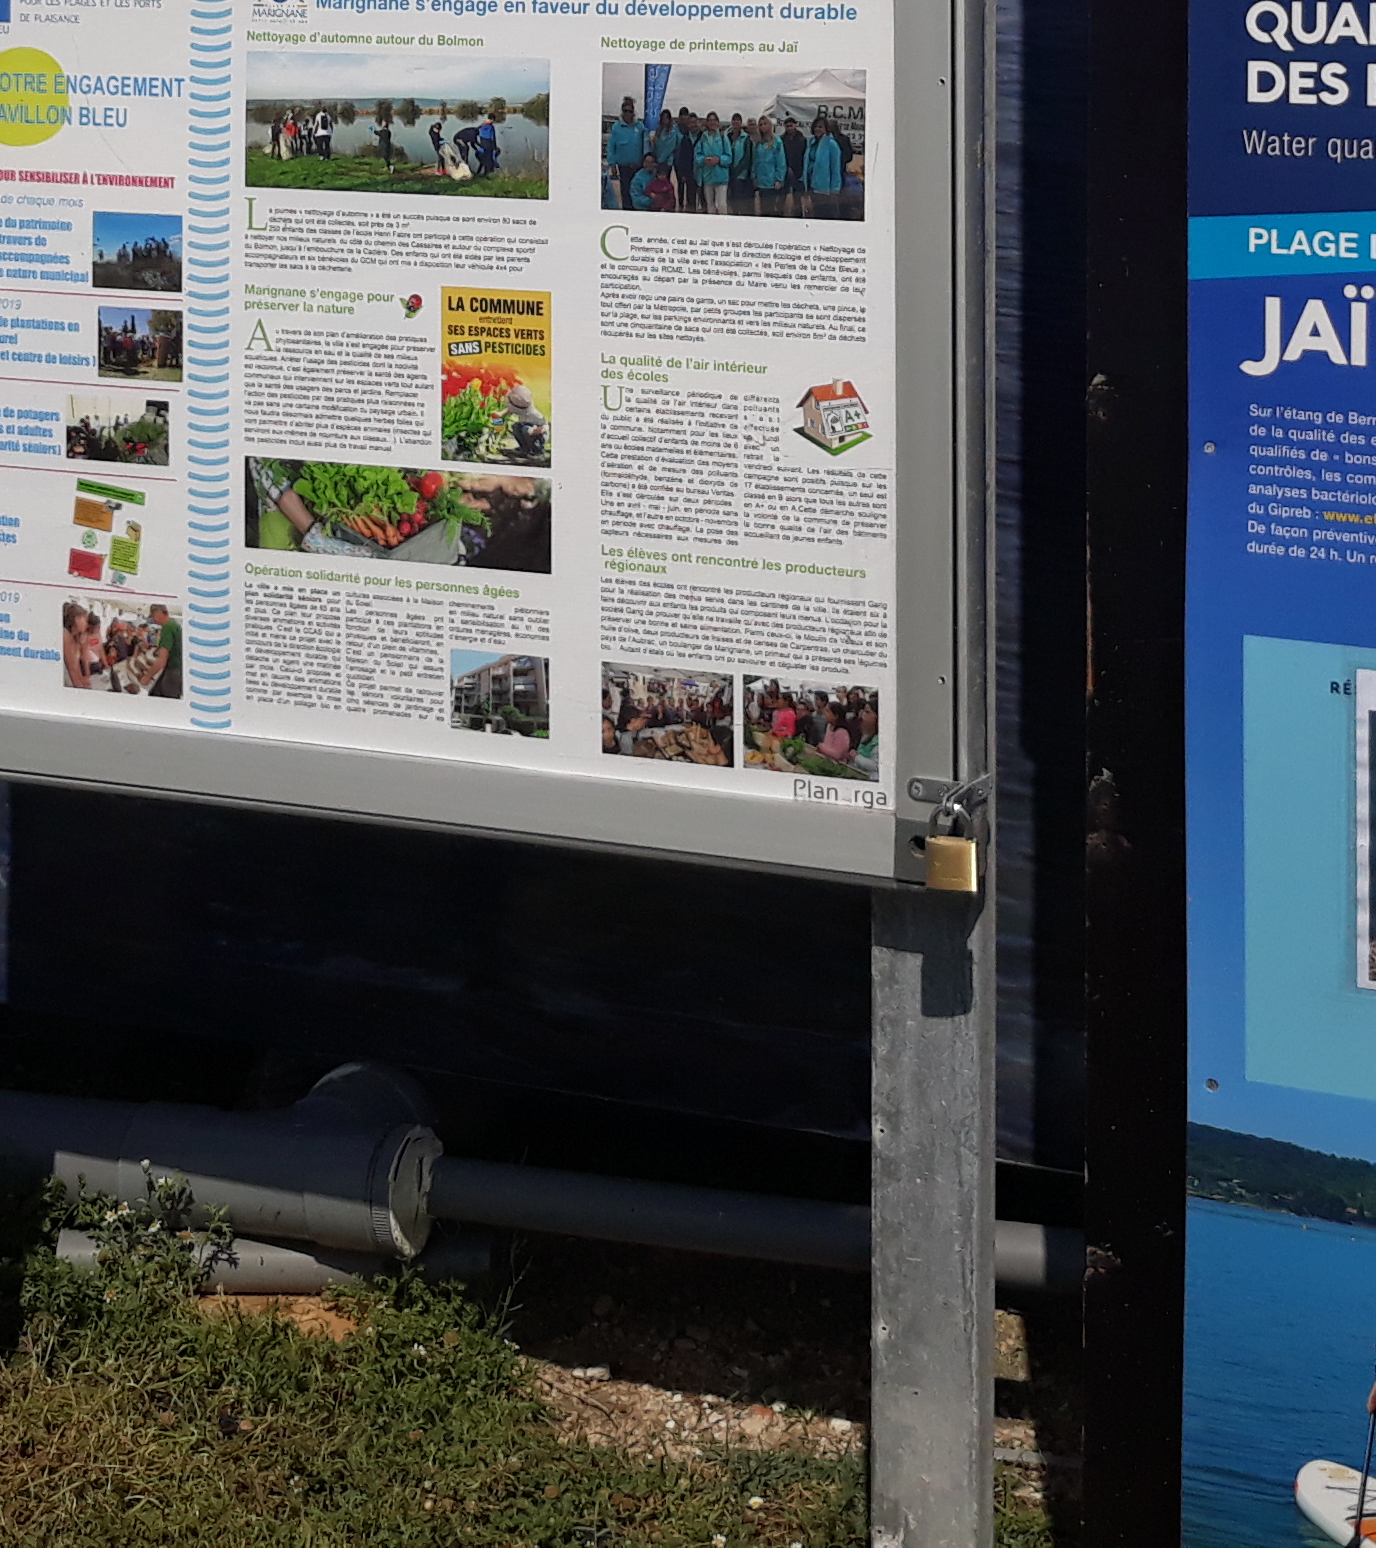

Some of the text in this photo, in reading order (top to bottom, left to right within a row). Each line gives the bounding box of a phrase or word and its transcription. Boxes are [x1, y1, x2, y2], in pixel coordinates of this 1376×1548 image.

[504, 1, 525, 13] en
[596, 0, 618, 15] du
[625, 0, 773, 20] développement
[780, 3, 857, 20] durable
[54, 73, 185, 97] ENGAGEMENT
[1248, 61, 1349, 105] DES
[79, 107, 127, 127] BLEU
[1243, 130, 1316, 156] Water
[1249, 228, 1358, 258] PLAGE
[448, 296, 543, 316] LA COMMUNE
[1240, 285, 1374, 376] JAÏ
[449, 341, 545, 356] SANS PESTICIDES
